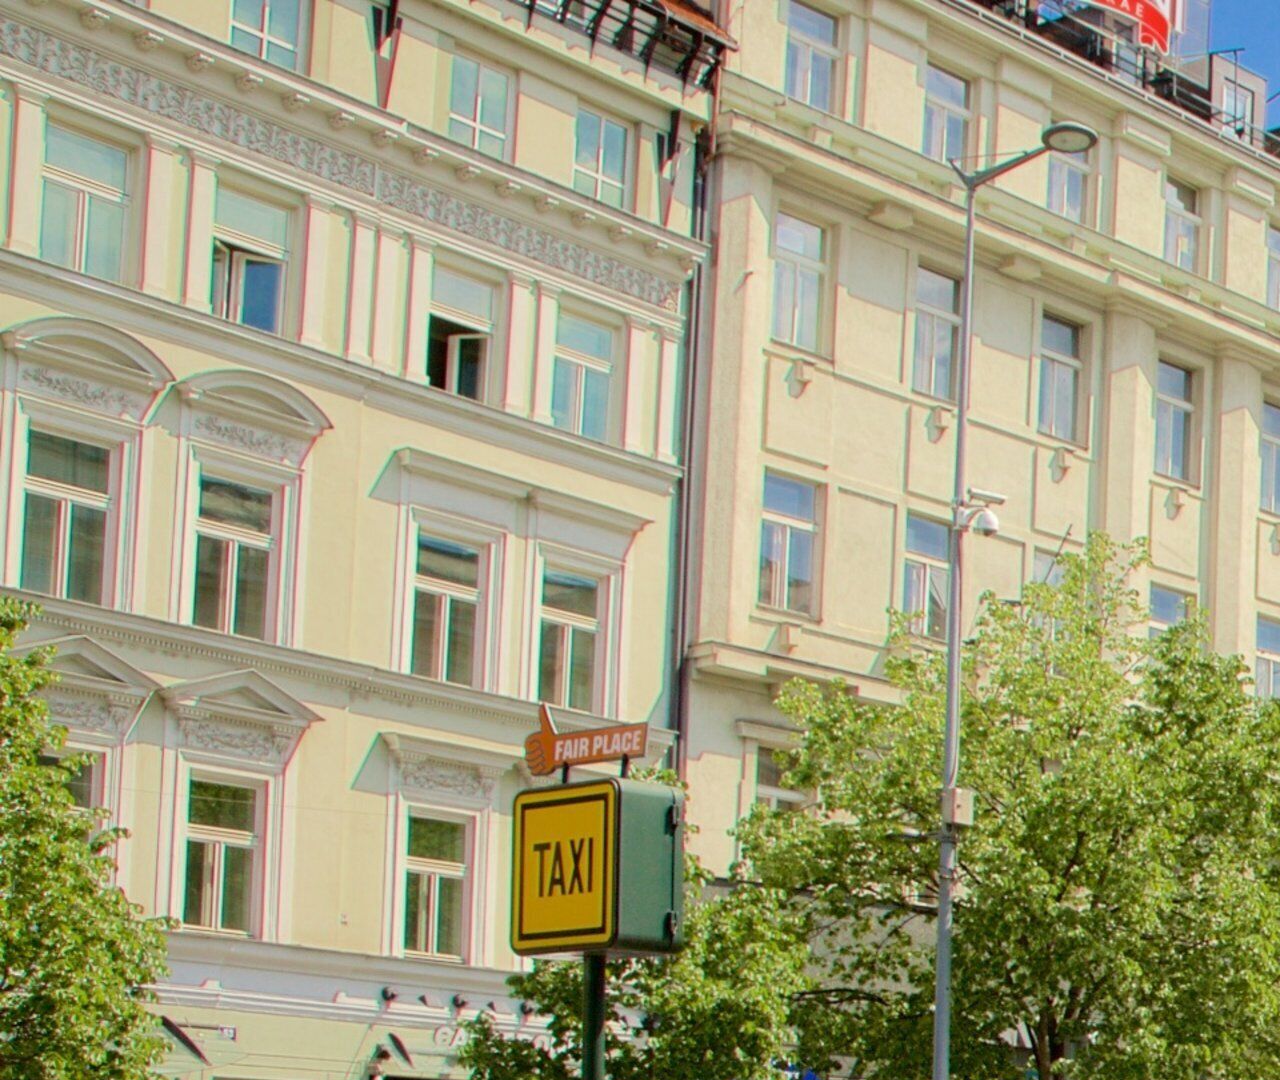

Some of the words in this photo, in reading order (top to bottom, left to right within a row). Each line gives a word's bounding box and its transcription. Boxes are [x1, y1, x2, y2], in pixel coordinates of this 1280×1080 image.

[554, 737, 589, 762] FAIR
[592, 730, 643, 757] PLACE
[533, 837, 593, 898] TAXI
